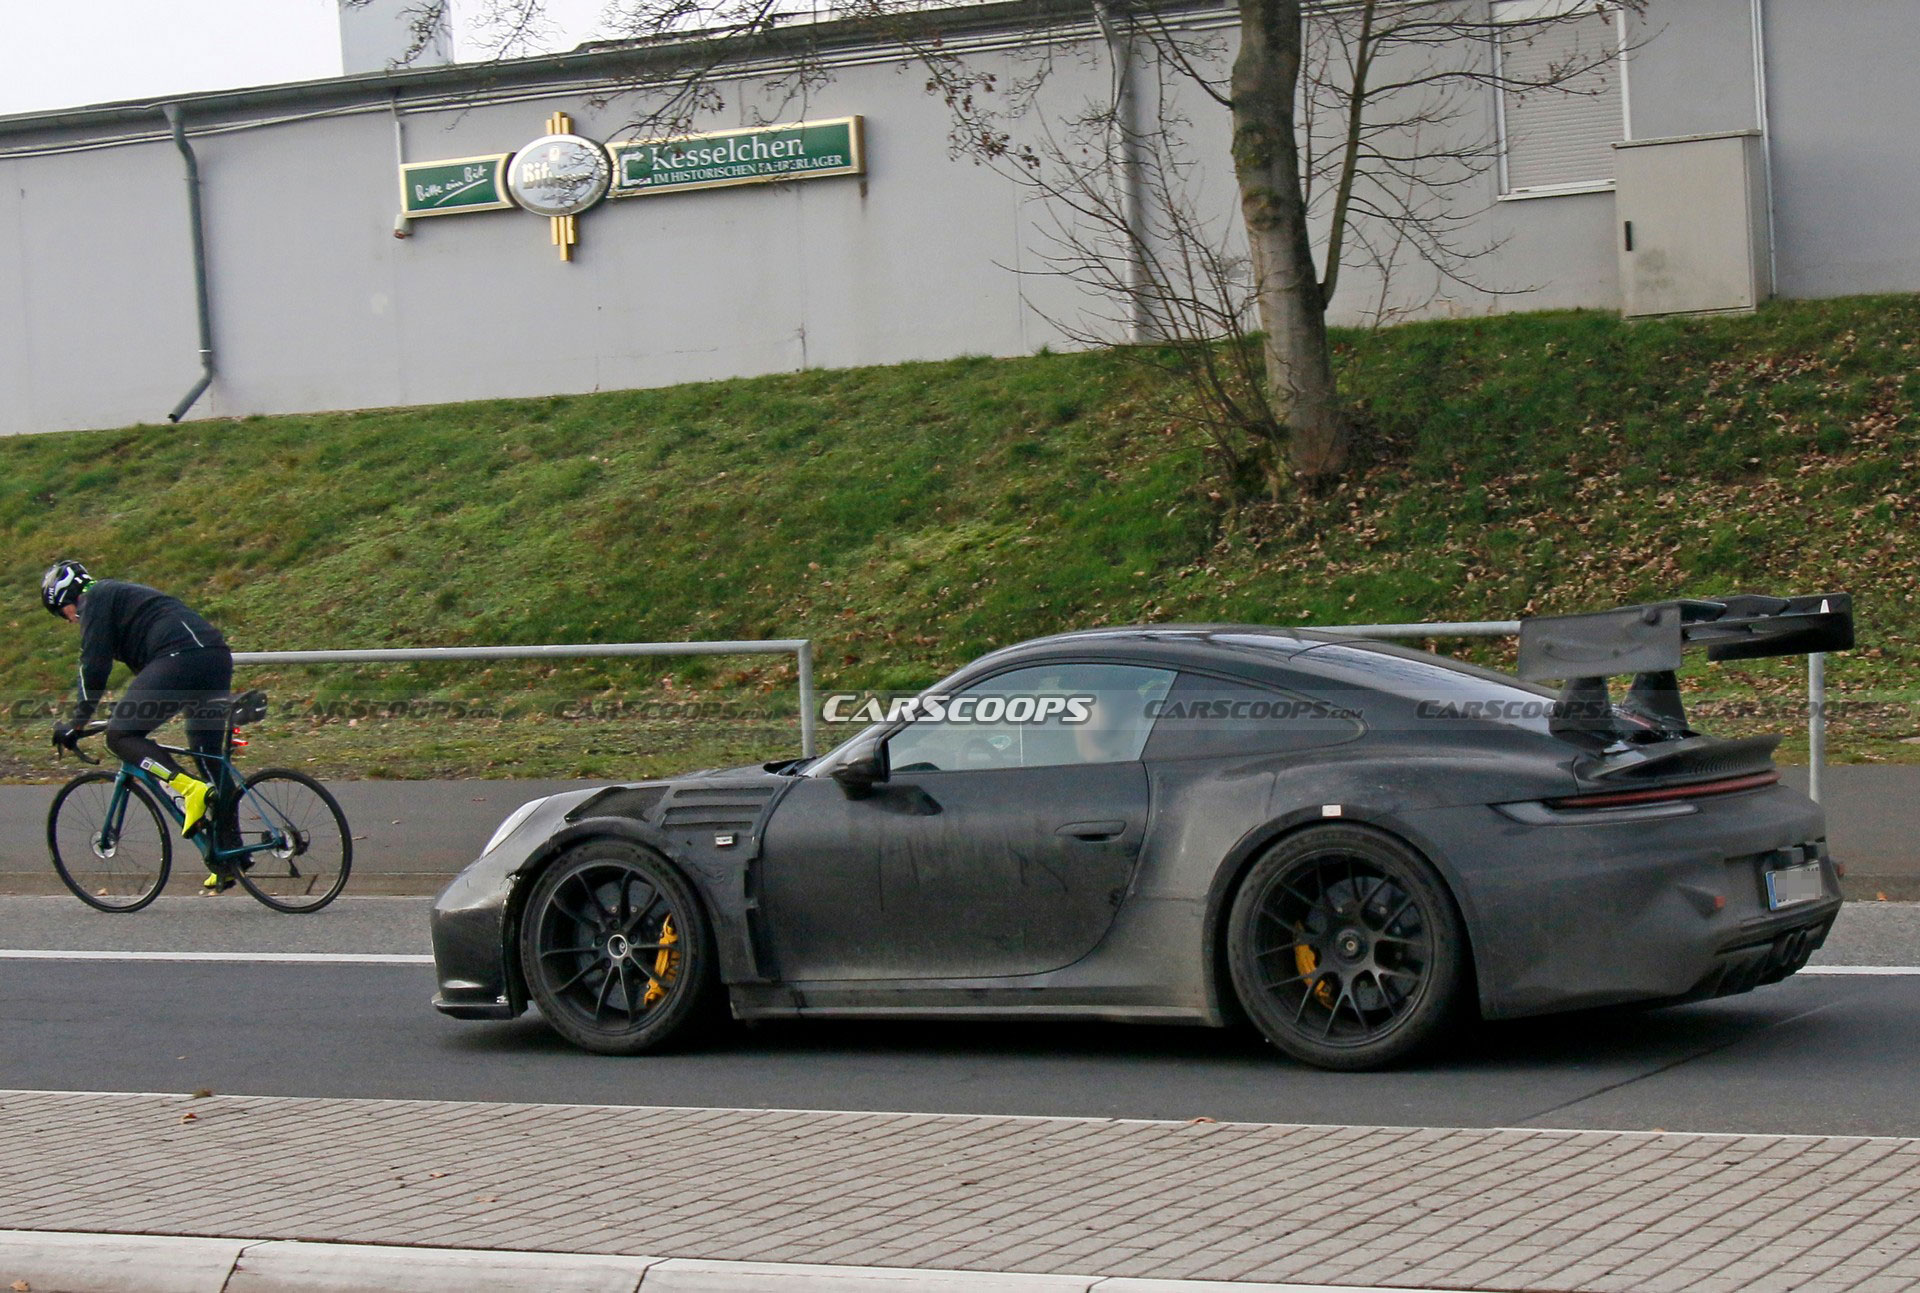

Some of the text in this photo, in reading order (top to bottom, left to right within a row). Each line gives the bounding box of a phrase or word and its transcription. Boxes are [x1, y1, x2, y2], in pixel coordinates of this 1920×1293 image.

[650, 136, 805, 170] Kesselchen
[464, 165, 487, 182] Bit
[653, 172, 669, 184] IM
[671, 162, 757, 183] HISTORISCHEN
